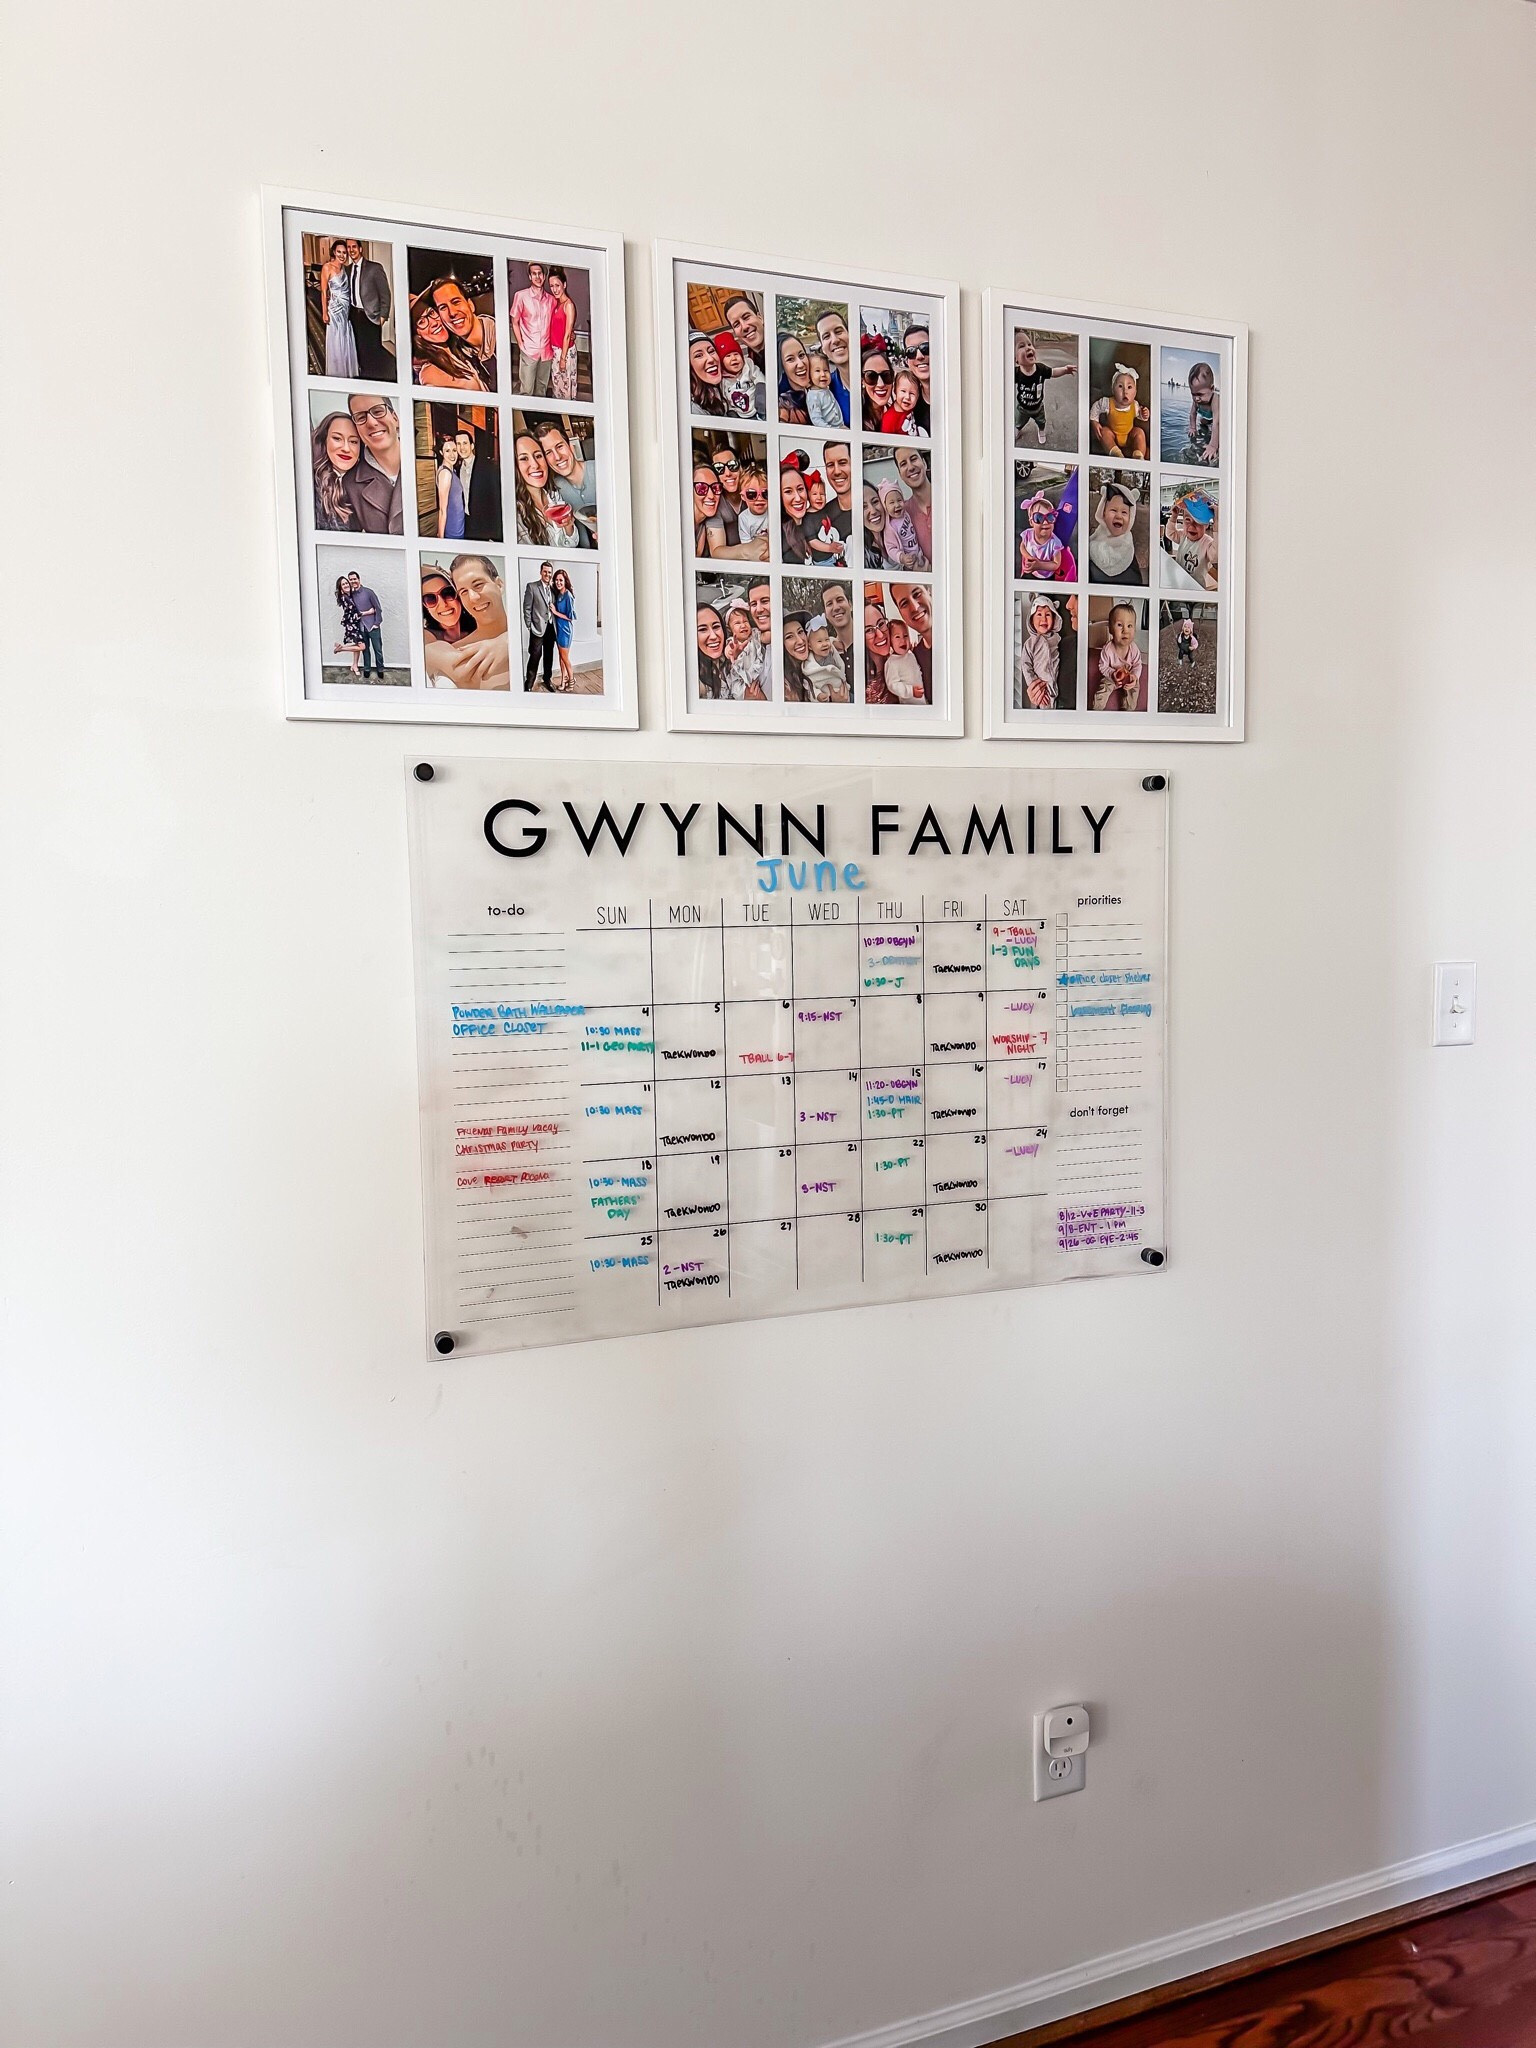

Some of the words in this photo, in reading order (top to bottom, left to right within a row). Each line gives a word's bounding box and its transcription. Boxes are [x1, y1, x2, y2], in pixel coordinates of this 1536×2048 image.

[484, 799, 826, 858] GWYNN
[871, 802, 1115, 856] FAMILY
[756, 857, 866, 893] June
[1077, 895, 1122, 907] priorities
[487, 904, 525, 917] to-do
[742, 903, 770, 922] TUE
[808, 902, 841, 921] WED
[876, 901, 903, 919] THU
[943, 900, 964, 918] FRI
[1003, 898, 1027, 917] SAT
[596, 906, 628, 925] SUN
[668, 904, 702, 924] MON
[976, 923, 982, 931] 2
[1039, 921, 1045, 930] 3
[863, 936, 885, 948] 10:20
[991, 944, 1008, 957] 1-3
[1011, 946, 1034, 957] FUN
[1014, 956, 1041, 970] DAYS
[916, 994, 922, 1004] 8
[978, 992, 984, 1001] 9
[1037, 991, 1047, 999] 10
[714, 1002, 721, 1013] 5
[783, 1000, 790, 1009] 6
[850, 999, 857, 1007] 7
[496, 1004, 527, 1019] BATH
[641, 1007, 650, 1017] 4
[585, 1026, 610, 1036] 10:30
[614, 1026, 641, 1036] MASS
[993, 1034, 1030, 1045] WORSHIP
[1007, 1043, 1036, 1055] NIGHT
[739, 1053, 773, 1064] TBALL
[974, 1063, 984, 1072] 16
[1038, 1061, 1047, 1070] 17
[848, 1072, 858, 1081] 14
[911, 1068, 922, 1078] 15
[711, 1080, 721, 1089] 12
[782, 1077, 791, 1085] 13
[585, 1106, 610, 1117] 10:30
[615, 1105, 643, 1116] MASS
[1070, 1106, 1094, 1118] don't
[1098, 1105, 1129, 1118] forget
[1036, 1129, 1048, 1139] 24
[912, 1139, 924, 1148] 22
[974, 1136, 987, 1145] 23
[847, 1143, 857, 1152] 21
[779, 1149, 792, 1157] 20
[711, 1155, 720, 1165] 19
[641, 1161, 652, 1170] 18
[911, 1208, 924, 1217] 29
[975, 1203, 987, 1212] 30
[607, 1209, 631, 1221] DAY
[847, 1213, 860, 1222] 28
[780, 1221, 792, 1231] 27
[1113, 1220, 1126, 1229] PM
[713, 1228, 727, 1237] 26
[640, 1235, 653, 1246] 25
